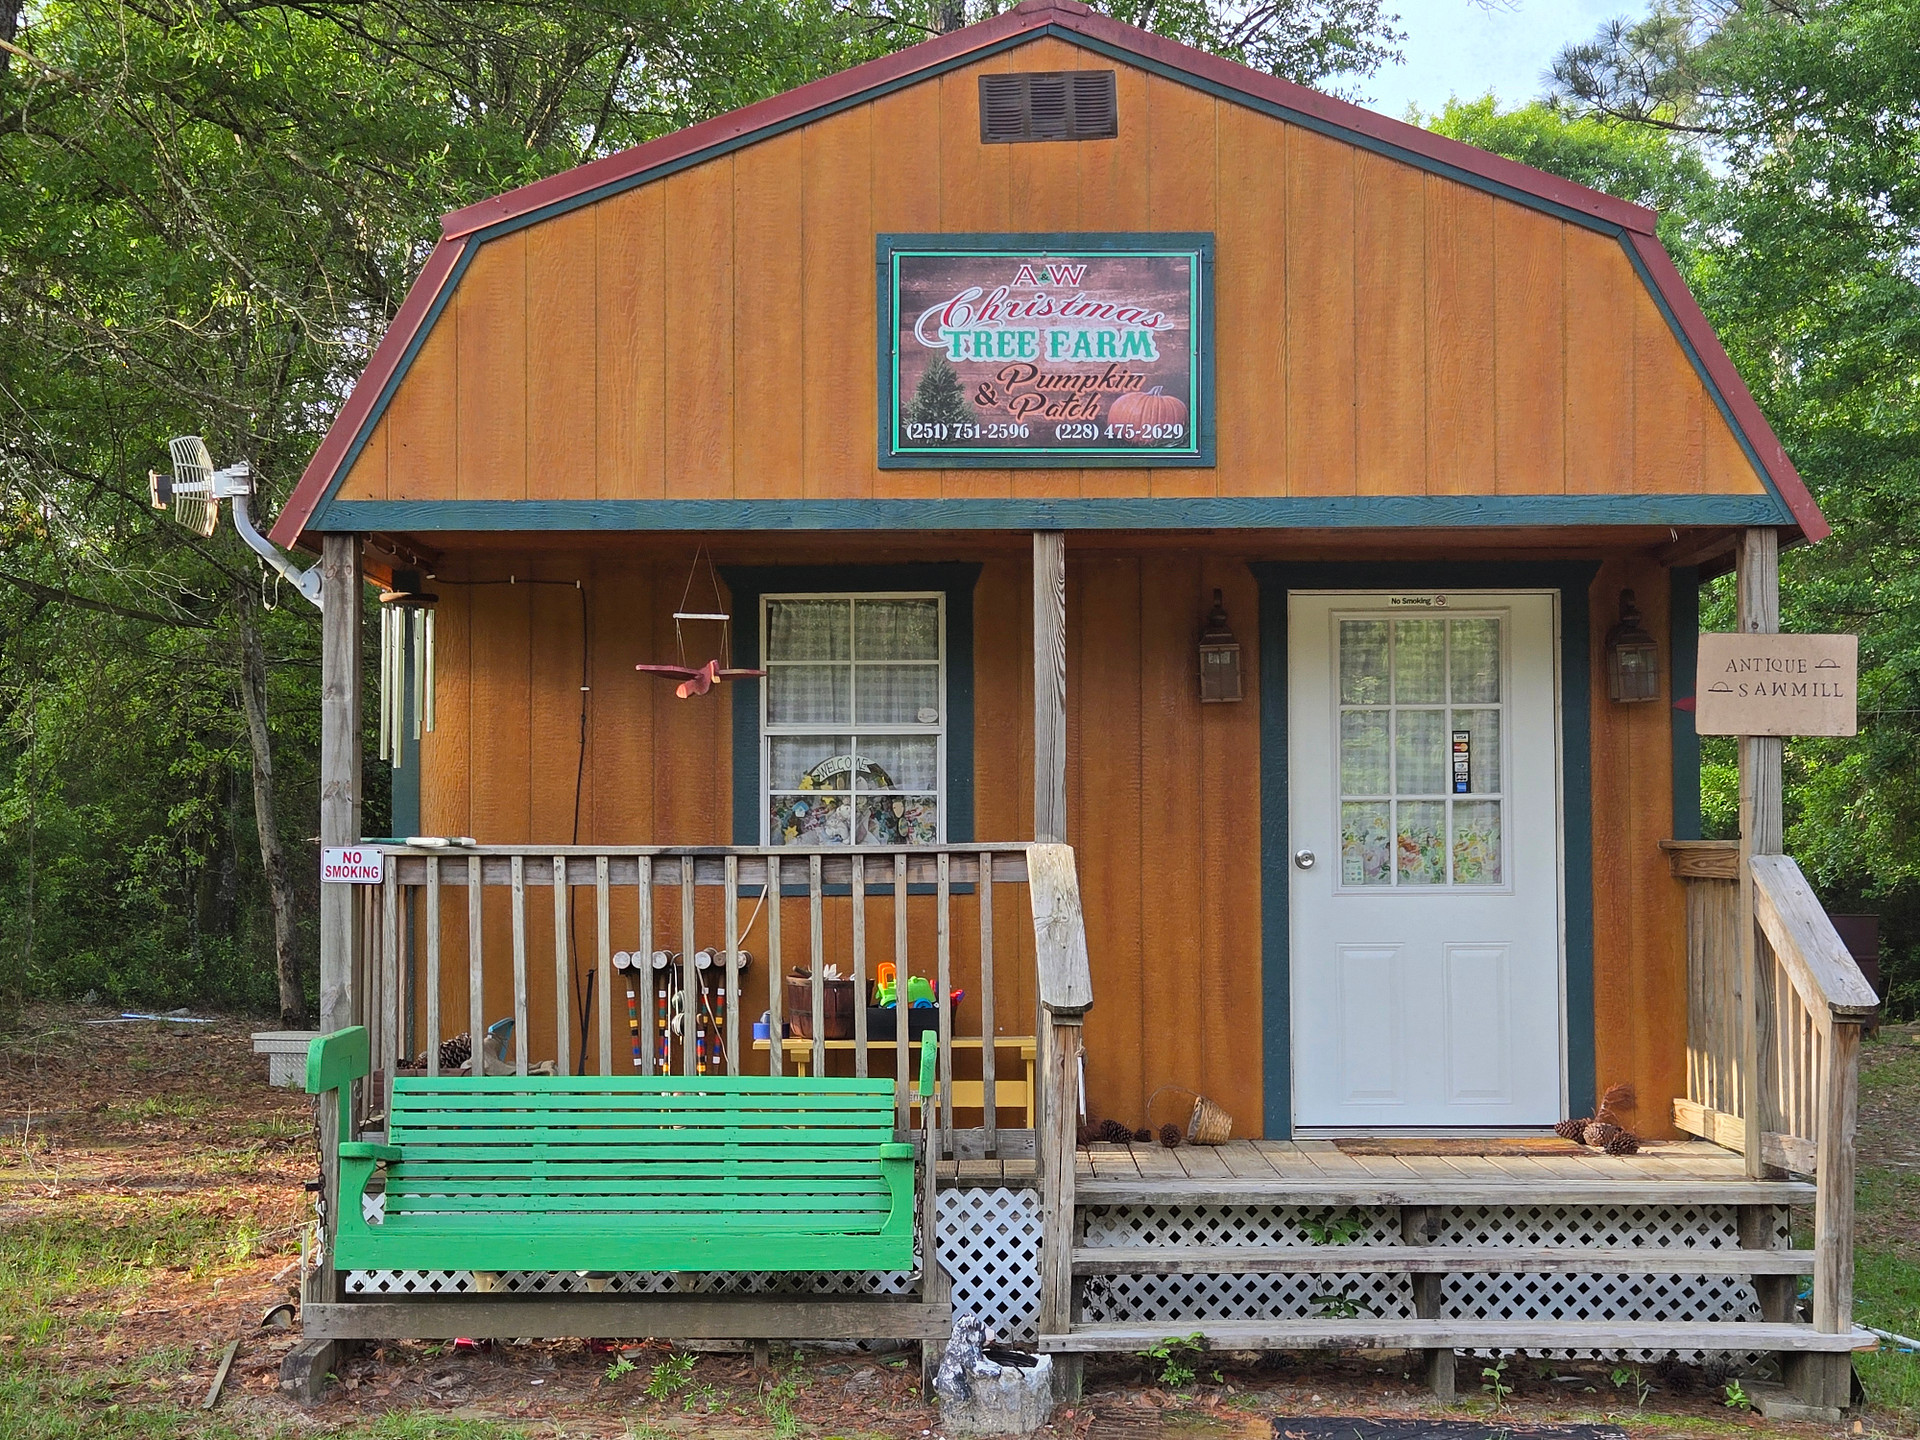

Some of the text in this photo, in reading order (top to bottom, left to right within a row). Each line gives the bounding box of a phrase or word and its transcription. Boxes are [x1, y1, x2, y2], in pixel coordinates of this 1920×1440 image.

[914, 286, 1174, 348] Christmas
[942, 329, 1155, 359] TREE FARM
[997, 363, 1145, 393] Pumpkin
[974, 381, 1101, 421] & Patch
[905, 423, 1030, 440] (251) 751-2596
[1055, 423, 1184, 440] (228) 475-2629
[1402, 597, 1432, 606] Smoking
[1725, 658, 1808, 674] ANTIQUE
[1738, 682, 1844, 698] SAWMILL
[342, 851, 363, 864] NO
[325, 865, 379, 879] SMOKING
